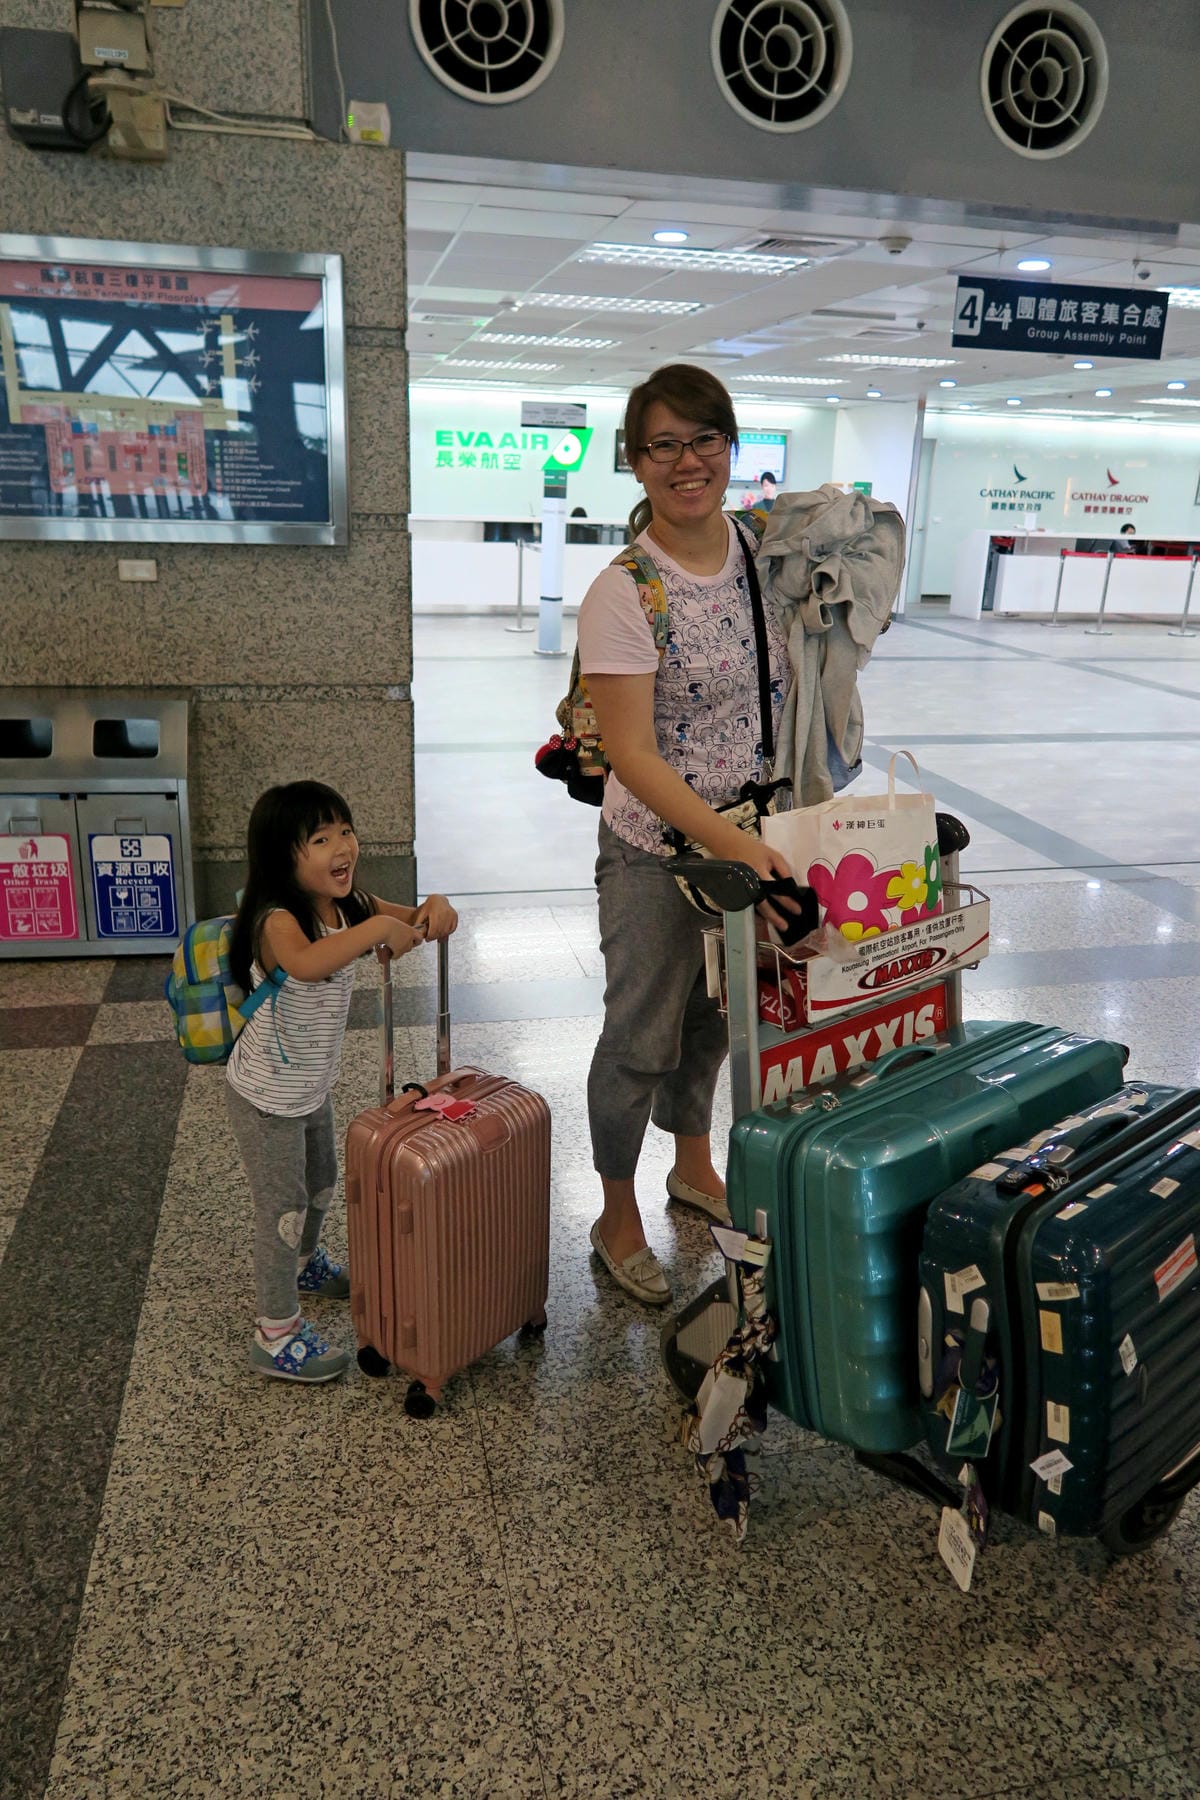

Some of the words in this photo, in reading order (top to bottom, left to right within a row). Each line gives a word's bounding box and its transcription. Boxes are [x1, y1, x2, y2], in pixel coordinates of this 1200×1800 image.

[93, 290, 138, 299] Terminal
[958, 295, 978, 329] 4
[1016, 296, 1163, 328] 團體旅客集合處
[1027, 327, 1059, 340] Group
[1064, 329, 1114, 345] Assembly
[1120, 333, 1147, 345] Point
[435, 430, 494, 448] EVA
[498, 432, 549, 451] AIR
[435, 450, 522, 471] 長榮航空
[979, 488, 1018, 499] CATHAY
[1018, 489, 1056, 501] PACIFIC
[1071, 491, 1108, 502] CATHAY
[1110, 493, 1149, 504] DRAGON
[845, 818, 886, 830] 漢神巨蛋
[0, 863, 69, 878] 一般垃圾
[97, 862, 170, 877] 資源回收
[3, 878, 30, 887] Other
[35, 878, 60, 886] Trash
[115, 877, 153, 886] Recycle
[919, 938, 927, 946] For
[955, 924, 966, 934] Only
[762, 1003, 935, 1107] MAXXIS
